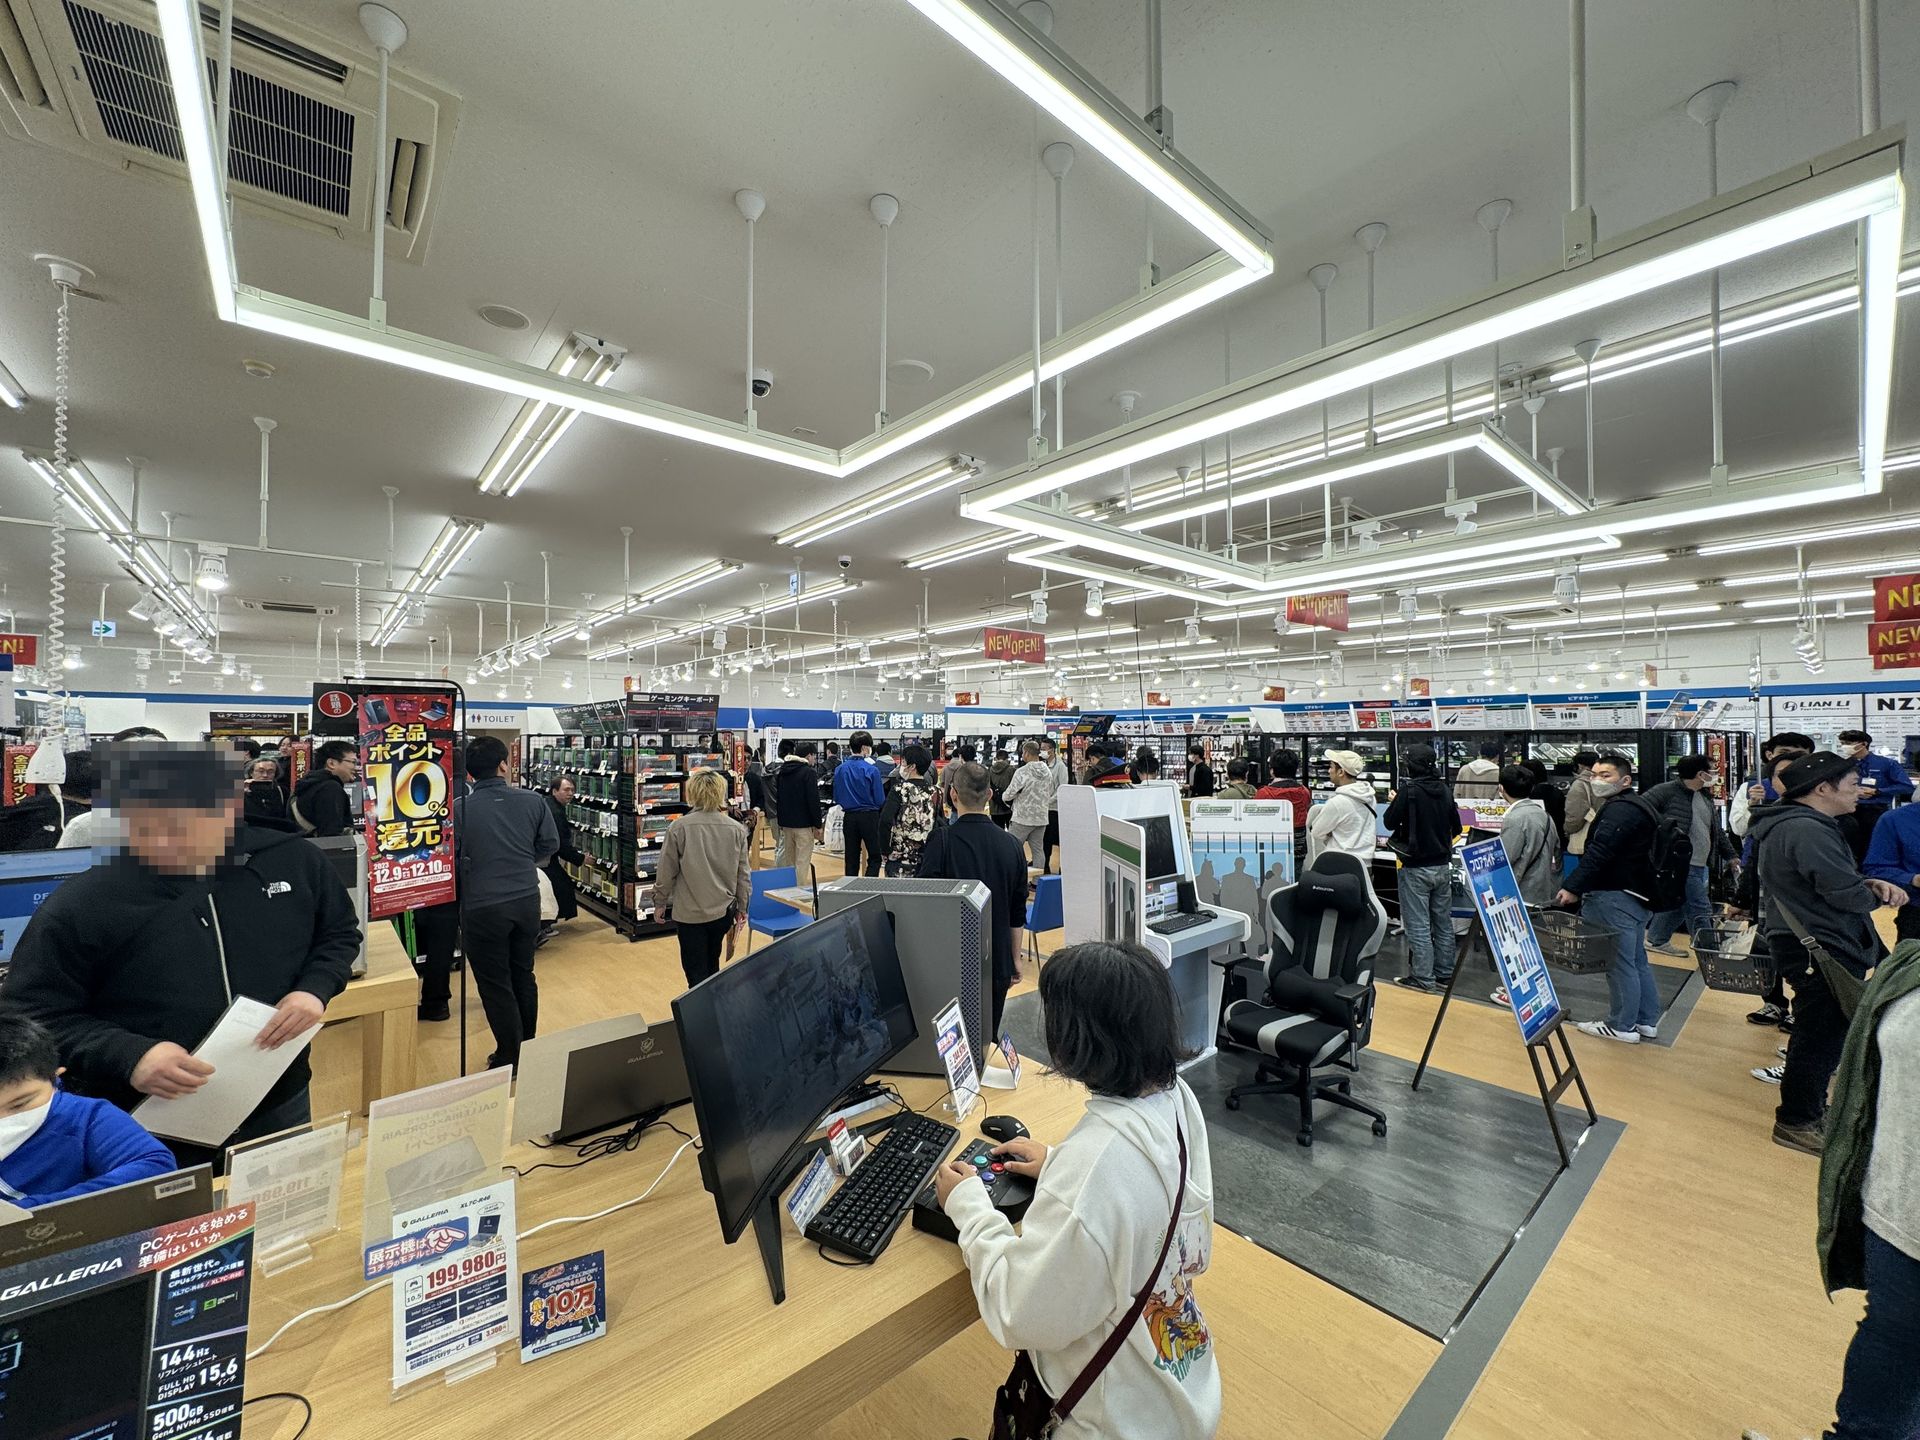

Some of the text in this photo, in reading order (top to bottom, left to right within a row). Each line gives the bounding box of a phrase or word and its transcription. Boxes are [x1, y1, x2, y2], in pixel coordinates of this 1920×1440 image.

[1314, 594, 1344, 618] OPEN!
[988, 634, 1040, 655] NEW OPEN!
[651, 695, 714, 703] ゲーミングキーボード
[484, 715, 515, 723] TOILET
[840, 712, 946, 729] 買取 修理・相談
[384, 723, 427, 742] 全品
[369, 742, 442, 762] ポイント
[365, 760, 449, 821] 10%
[377, 818, 441, 852] 還元
[409, 1208, 449, 1225] GALLERIA
[139, 1208, 249, 1256] PCゲームを始める
[0, 1256, 124, 1301] GALLERIA
[169, 1259, 221, 1280] 最新世代の
[426, 1250, 507, 1289] 199,980円
[545, 1281, 597, 1319] 10万
[157, 1353, 218, 1380] リフレッシュレート
[160, 1344, 210, 1371] 144Hz
[158, 1357, 238, 1393] FULL HD 15.6
[216, 1374, 237, 1387] インチ
[157, 1382, 195, 1401] DISPLAY
[152, 1403, 204, 1432] 500GB
[152, 1428, 174, 1440] Gen4
[176, 1419, 201, 1431] NVMe
